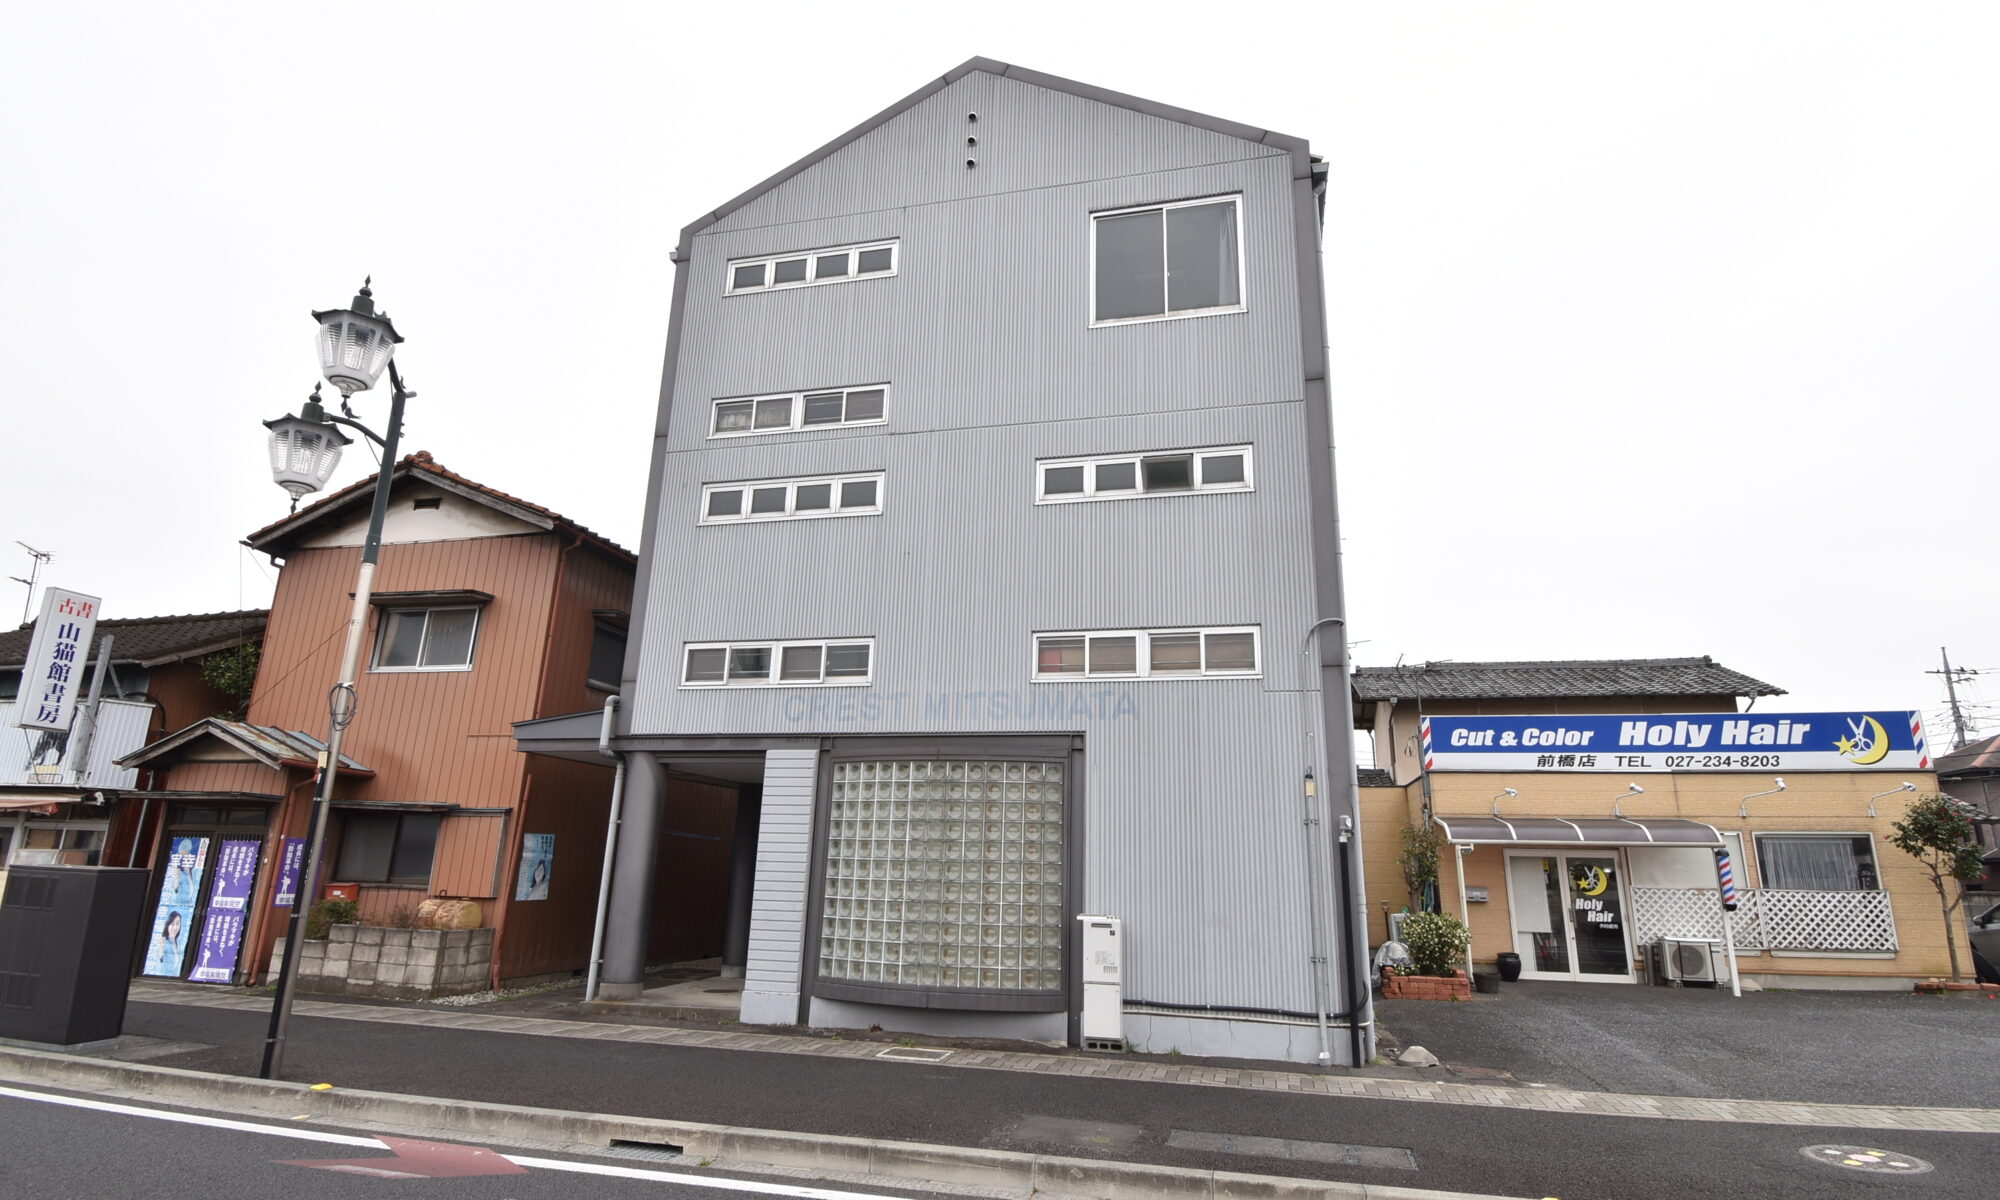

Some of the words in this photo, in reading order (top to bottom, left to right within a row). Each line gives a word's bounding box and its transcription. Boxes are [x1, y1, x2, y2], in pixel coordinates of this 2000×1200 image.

[58, 598, 93, 619] 古書
[36, 622, 81, 724] 山猫館書房
[783, 690, 908, 723] CREST
[924, 689, 1140, 722] MITSUMATA
[1450, 728, 1495, 747] Cut
[1499, 731, 1518, 747] &
[1521, 728, 1594, 746] Color
[1618, 721, 1712, 748] Holy
[1720, 720, 1811, 745] Hair
[1536, 754, 1597, 768] 前橋店
[1614, 755, 1652, 768] TEL
[1665, 755, 1781, 767] 027-234-8203
[1575, 898, 1603, 911] Holy
[1587, 911, 1614, 922] Hair
